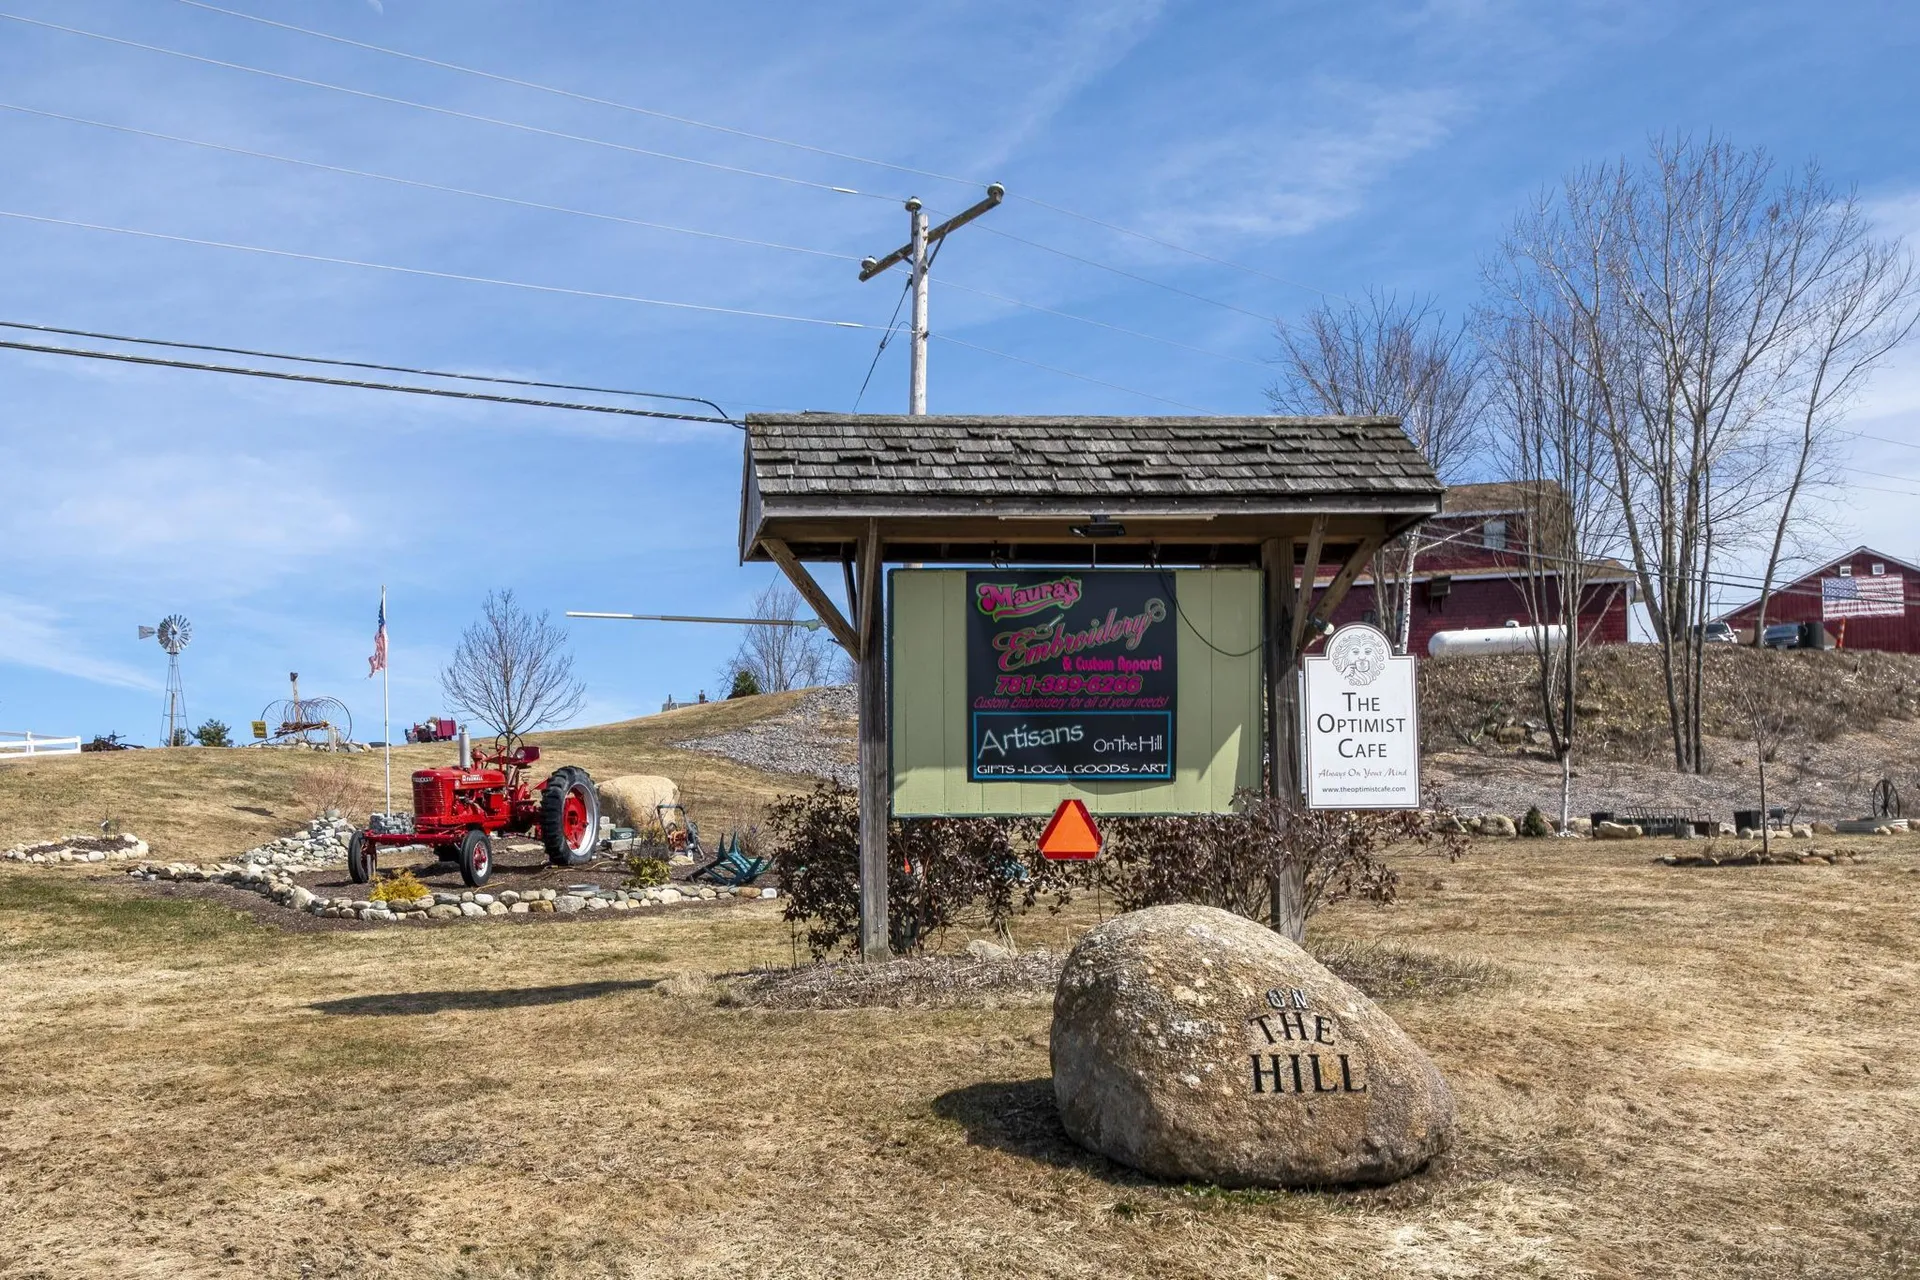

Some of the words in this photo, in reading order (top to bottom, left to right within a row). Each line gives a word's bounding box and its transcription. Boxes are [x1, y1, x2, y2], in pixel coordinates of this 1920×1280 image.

[977, 577, 1082, 621] Maura's
[993, 598, 1166, 671] Embroidery
[1062, 655, 1073, 672] &
[1076, 655, 1114, 671] Custom
[1117, 655, 1163, 675] Apparel
[995, 674, 1143, 695] 781-389-6266
[974, 696, 1010, 709] Custom
[1010, 696, 1065, 710] Embroidery
[1067, 696, 1083, 708] for
[1083, 696, 1097, 708] all
[1097, 696, 1109, 708] of
[1107, 698, 1134, 710] your
[1134, 696, 1169, 709] needs!
[977, 724, 1084, 760] Artisans
[1139, 735, 1162, 752] Hill
[976, 765, 1015, 774] GIFTS
[1073, 765, 1130, 774] GOODS
[1139, 764, 1167, 773] ART
[1318, 768, 1346, 779] Always
[1347, 768, 1361, 777] On
[1362, 767, 1382, 778] Your
[1383, 767, 1408, 778] Mind
[1322, 785, 1406, 793] www.theoptimistcafe.com
[1266, 988, 1310, 1009] ON
[1249, 1011, 1335, 1046] THE
[1250, 1053, 1368, 1093] HILL
